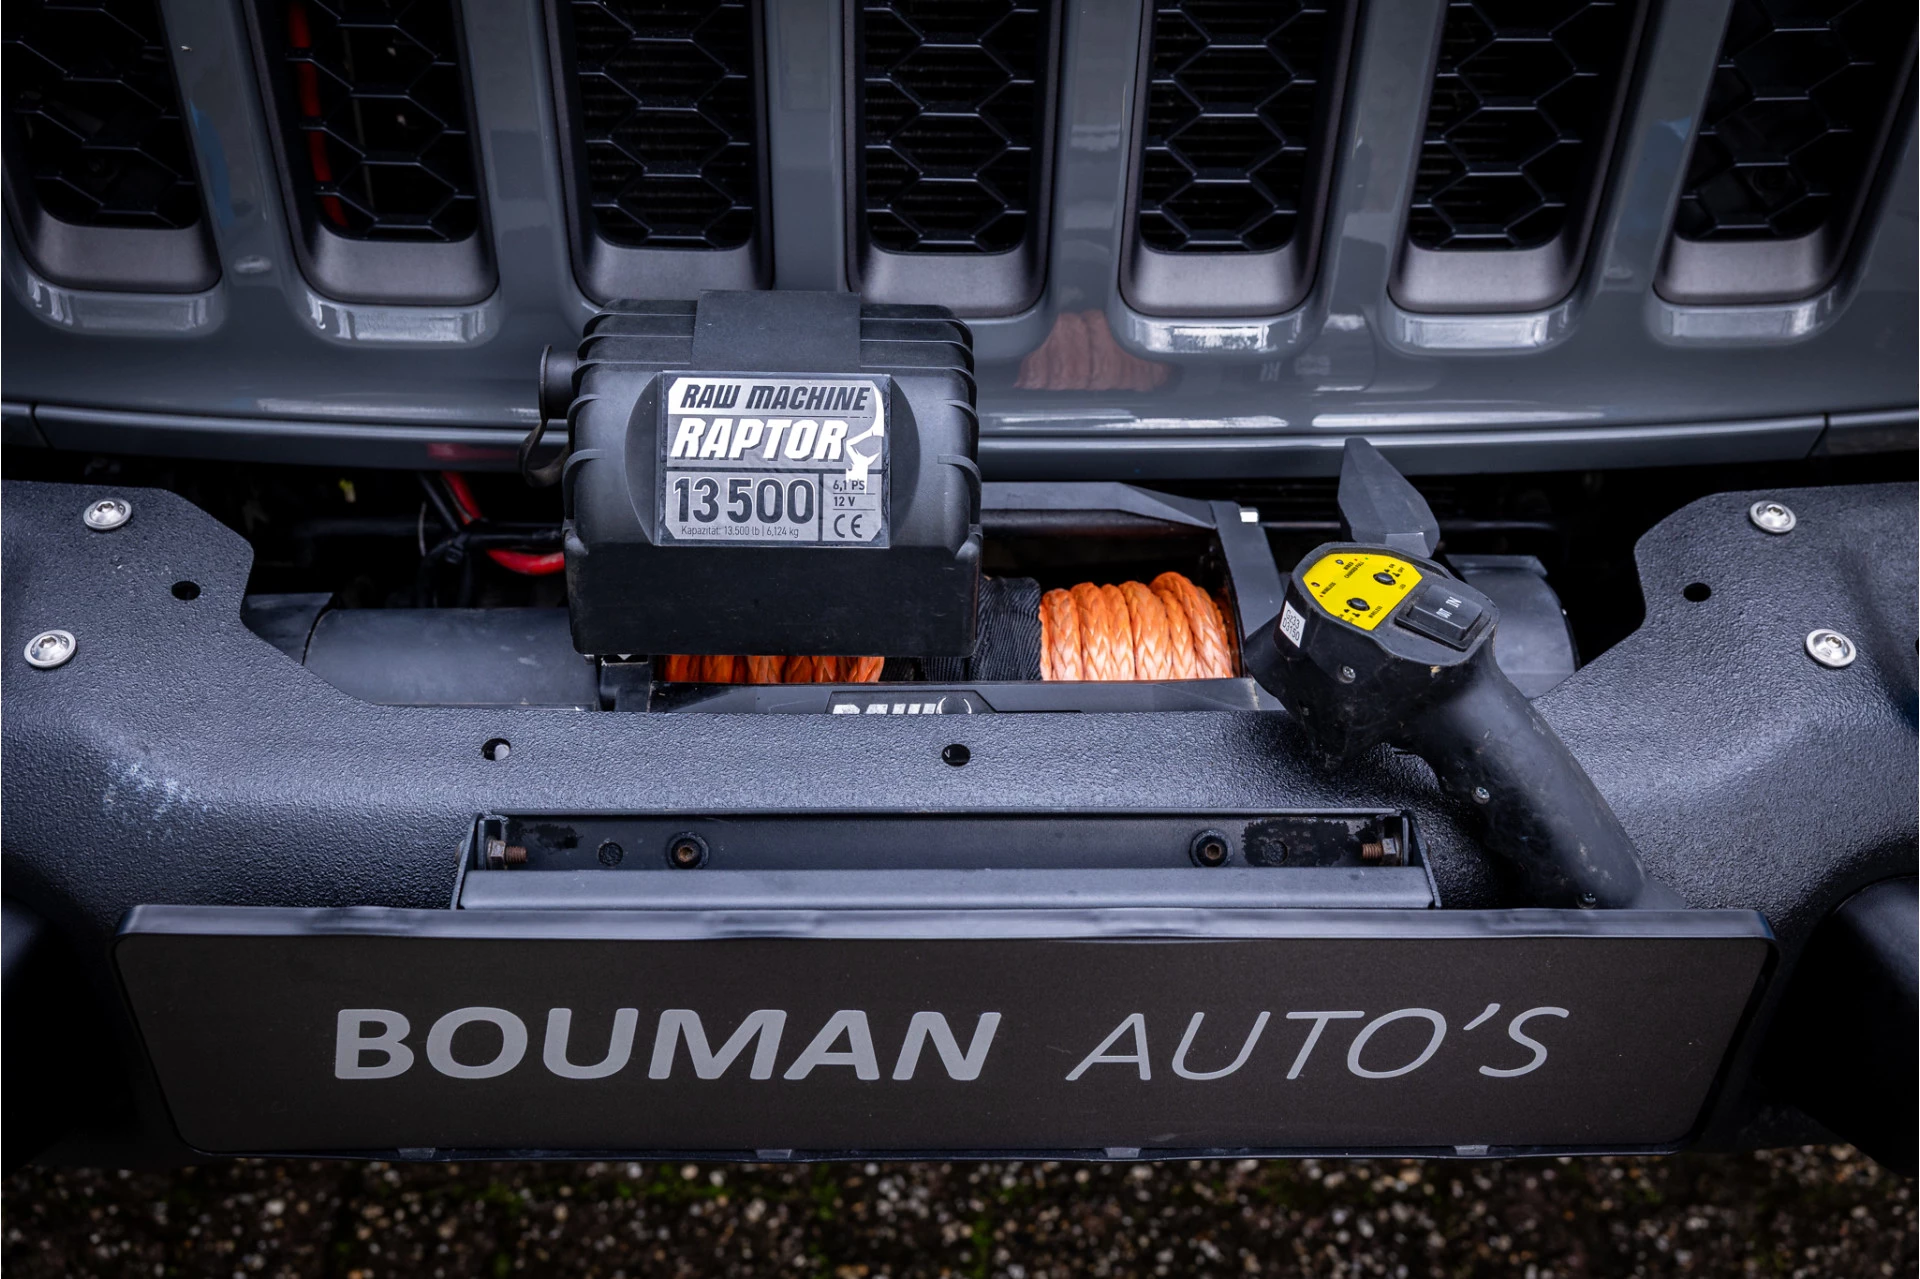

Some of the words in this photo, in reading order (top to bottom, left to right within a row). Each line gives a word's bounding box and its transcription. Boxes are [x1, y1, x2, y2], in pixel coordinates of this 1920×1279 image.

[680, 384, 742, 409] RAW
[745, 385, 871, 411] MACHINE
[670, 417, 849, 462] RAPTOR
[833, 480, 847, 492] 6,1
[851, 480, 866, 491] PS
[833, 496, 846, 507] 12
[848, 496, 856, 507] V
[724, 525, 750, 536] 13.500
[751, 525, 760, 536] lb
[766, 525, 787, 537] 6,124
[789, 526, 799, 539] kg
[334, 1006, 1003, 1082] BOUMAN
[1065, 1002, 1571, 1082] AUTO'S
